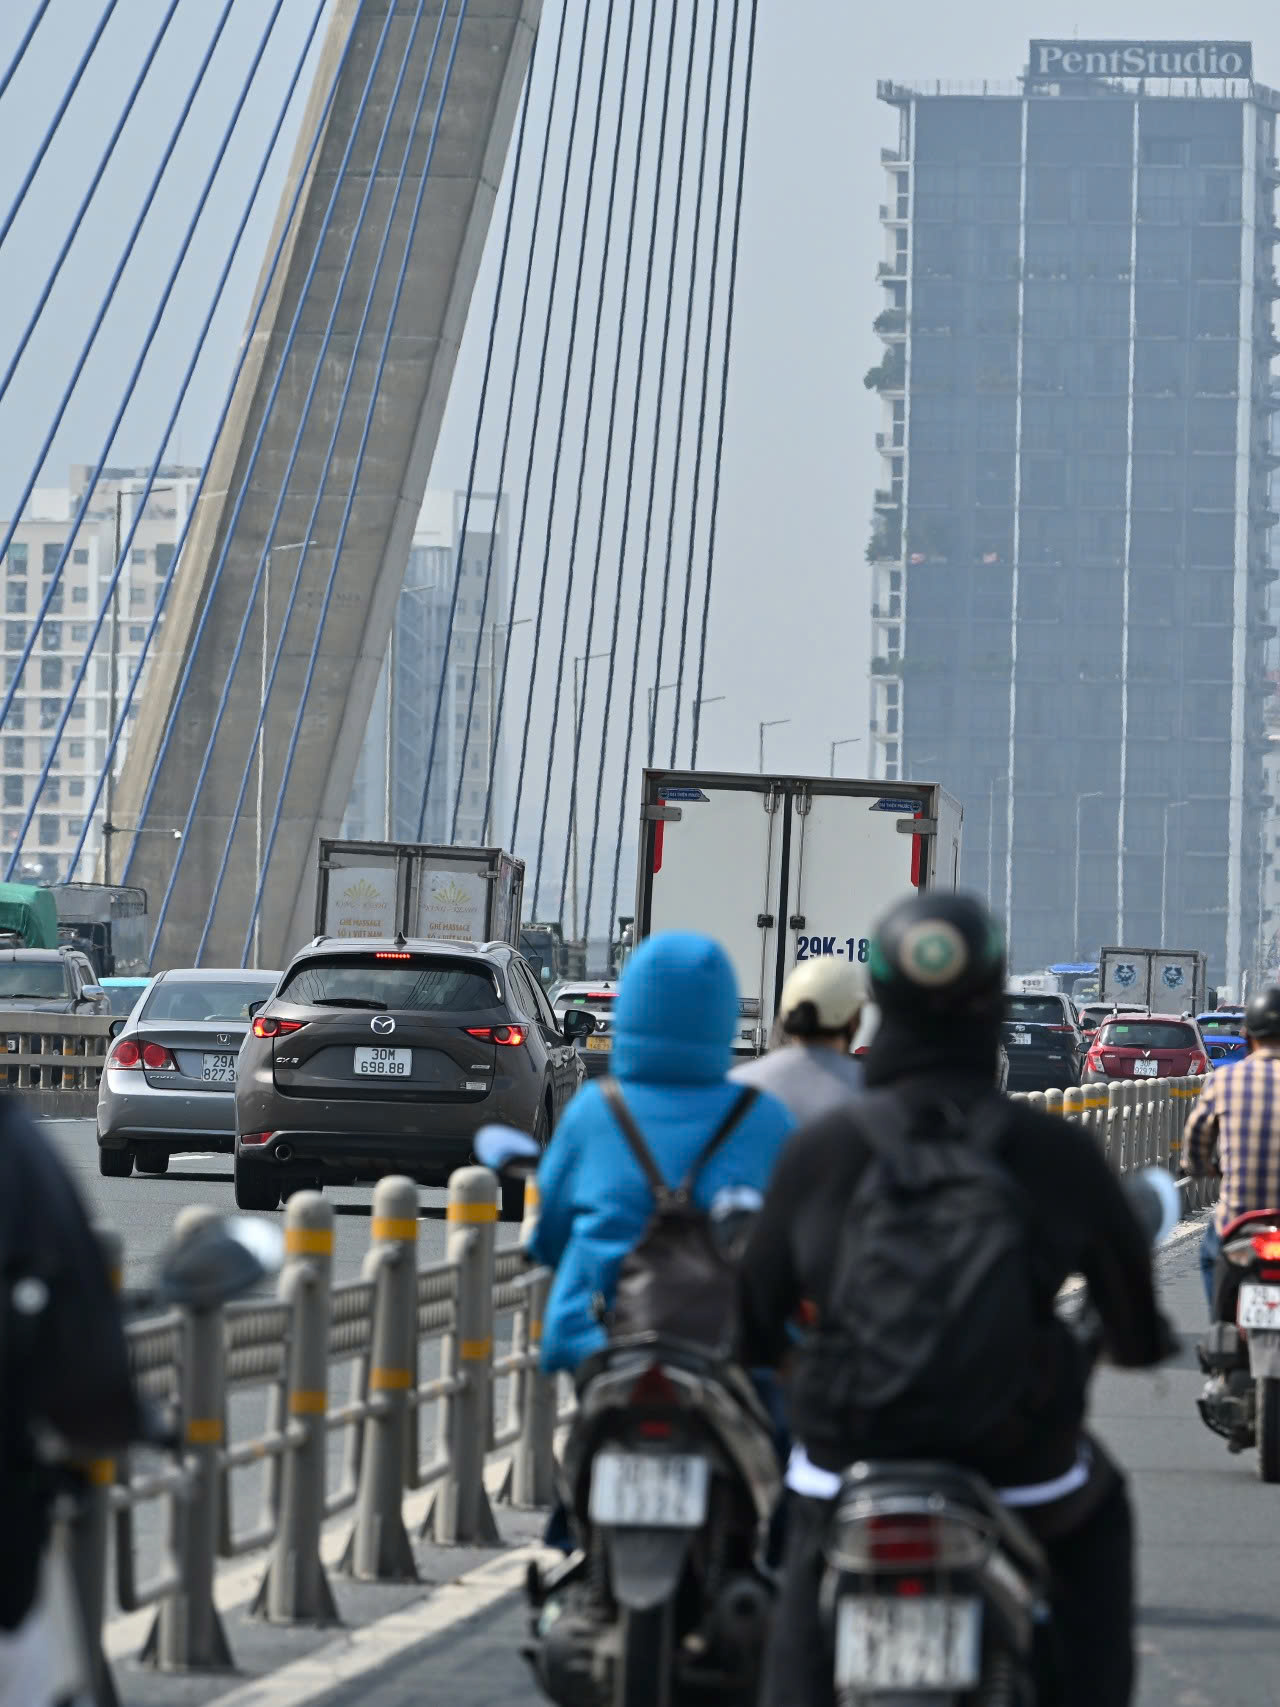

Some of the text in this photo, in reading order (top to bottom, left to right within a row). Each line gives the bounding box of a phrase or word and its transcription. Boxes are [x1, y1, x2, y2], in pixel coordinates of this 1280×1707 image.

[1038, 47, 1242, 74] PentStudio
[353, 919, 382, 927] MASSAGE
[442, 923, 471, 931] MASSAGE
[371, 1049, 396, 1061] 30M
[213, 1055, 235, 1069] 29A
[361, 1061, 405, 1074] 698.88
[203, 1068, 238, 1082] 827.3
